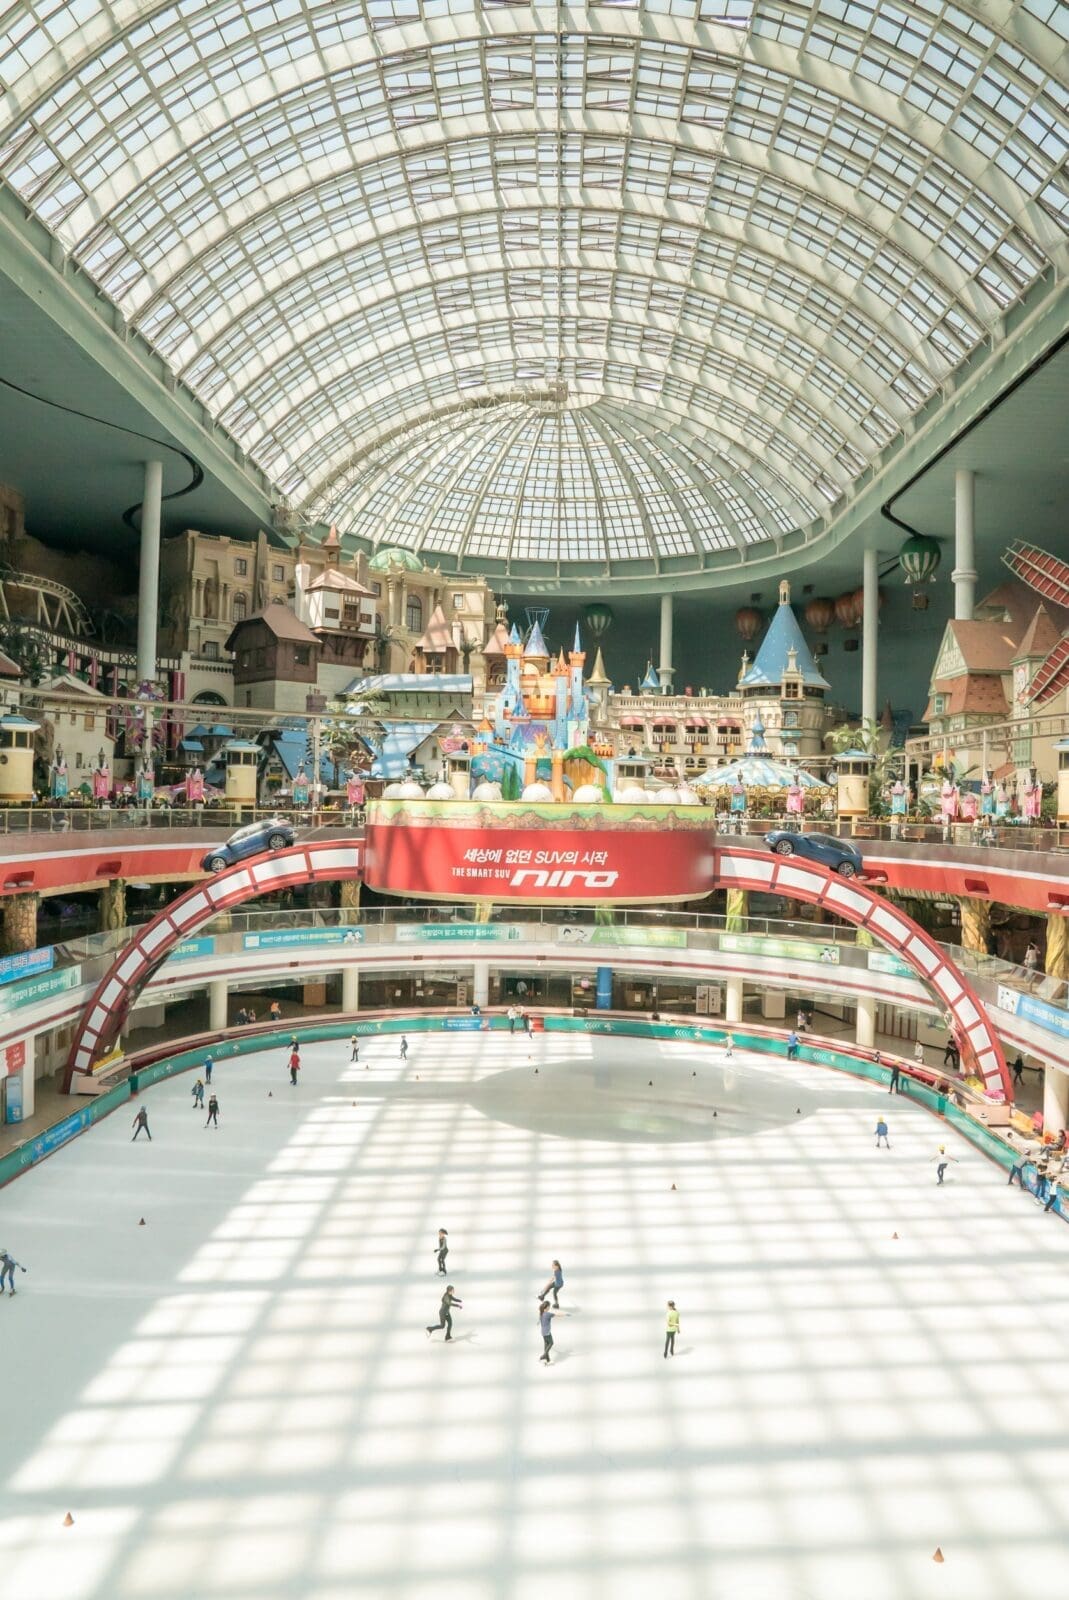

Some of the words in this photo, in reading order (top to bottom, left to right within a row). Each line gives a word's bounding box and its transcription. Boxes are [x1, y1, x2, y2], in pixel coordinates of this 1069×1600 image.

[464, 848, 503, 863] 세상에
[505, 849, 533, 864] 없던
[534, 850, 579, 865] SUV의
[581, 851, 608, 866] 시작
[452, 867, 464, 876] THE
[466, 867, 492, 878] SMART
[494, 868, 511, 878] SUV
[509, 869, 619, 888] niro
